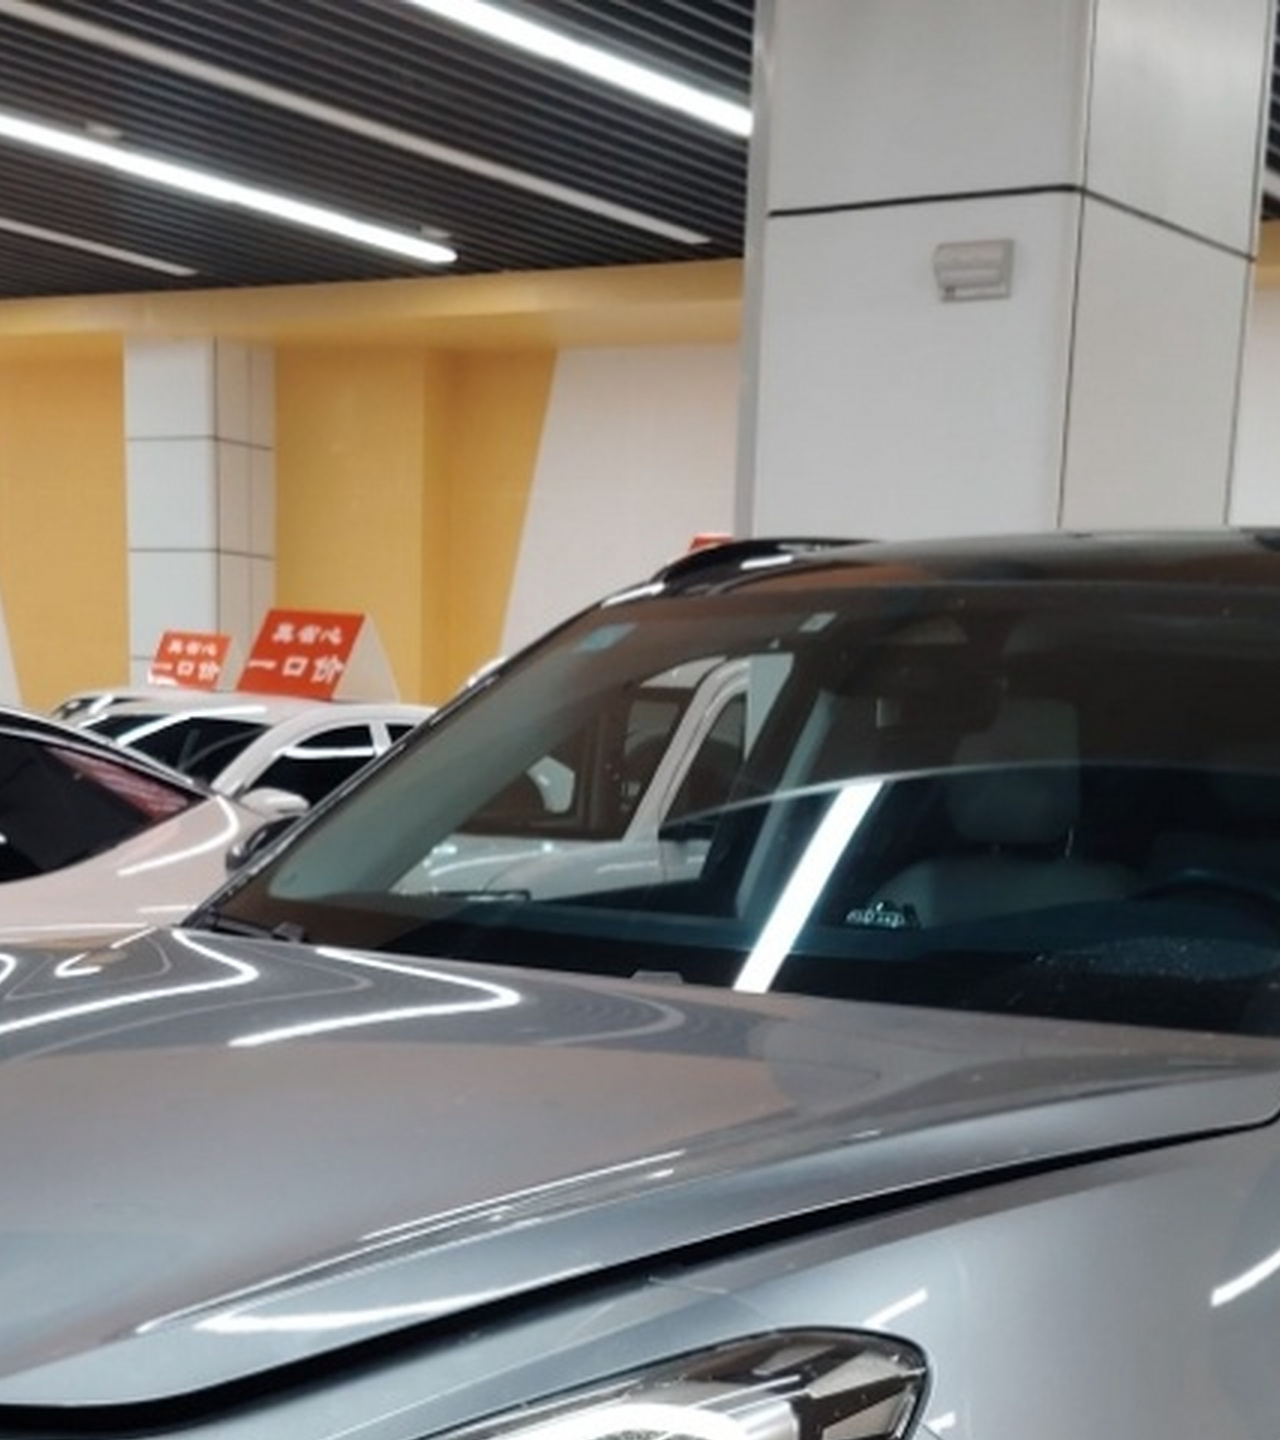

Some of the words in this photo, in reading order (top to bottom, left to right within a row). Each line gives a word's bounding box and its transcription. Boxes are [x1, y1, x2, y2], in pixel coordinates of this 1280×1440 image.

[152, 660, 220, 682] 一口价
[248, 656, 344, 684] 一口价
